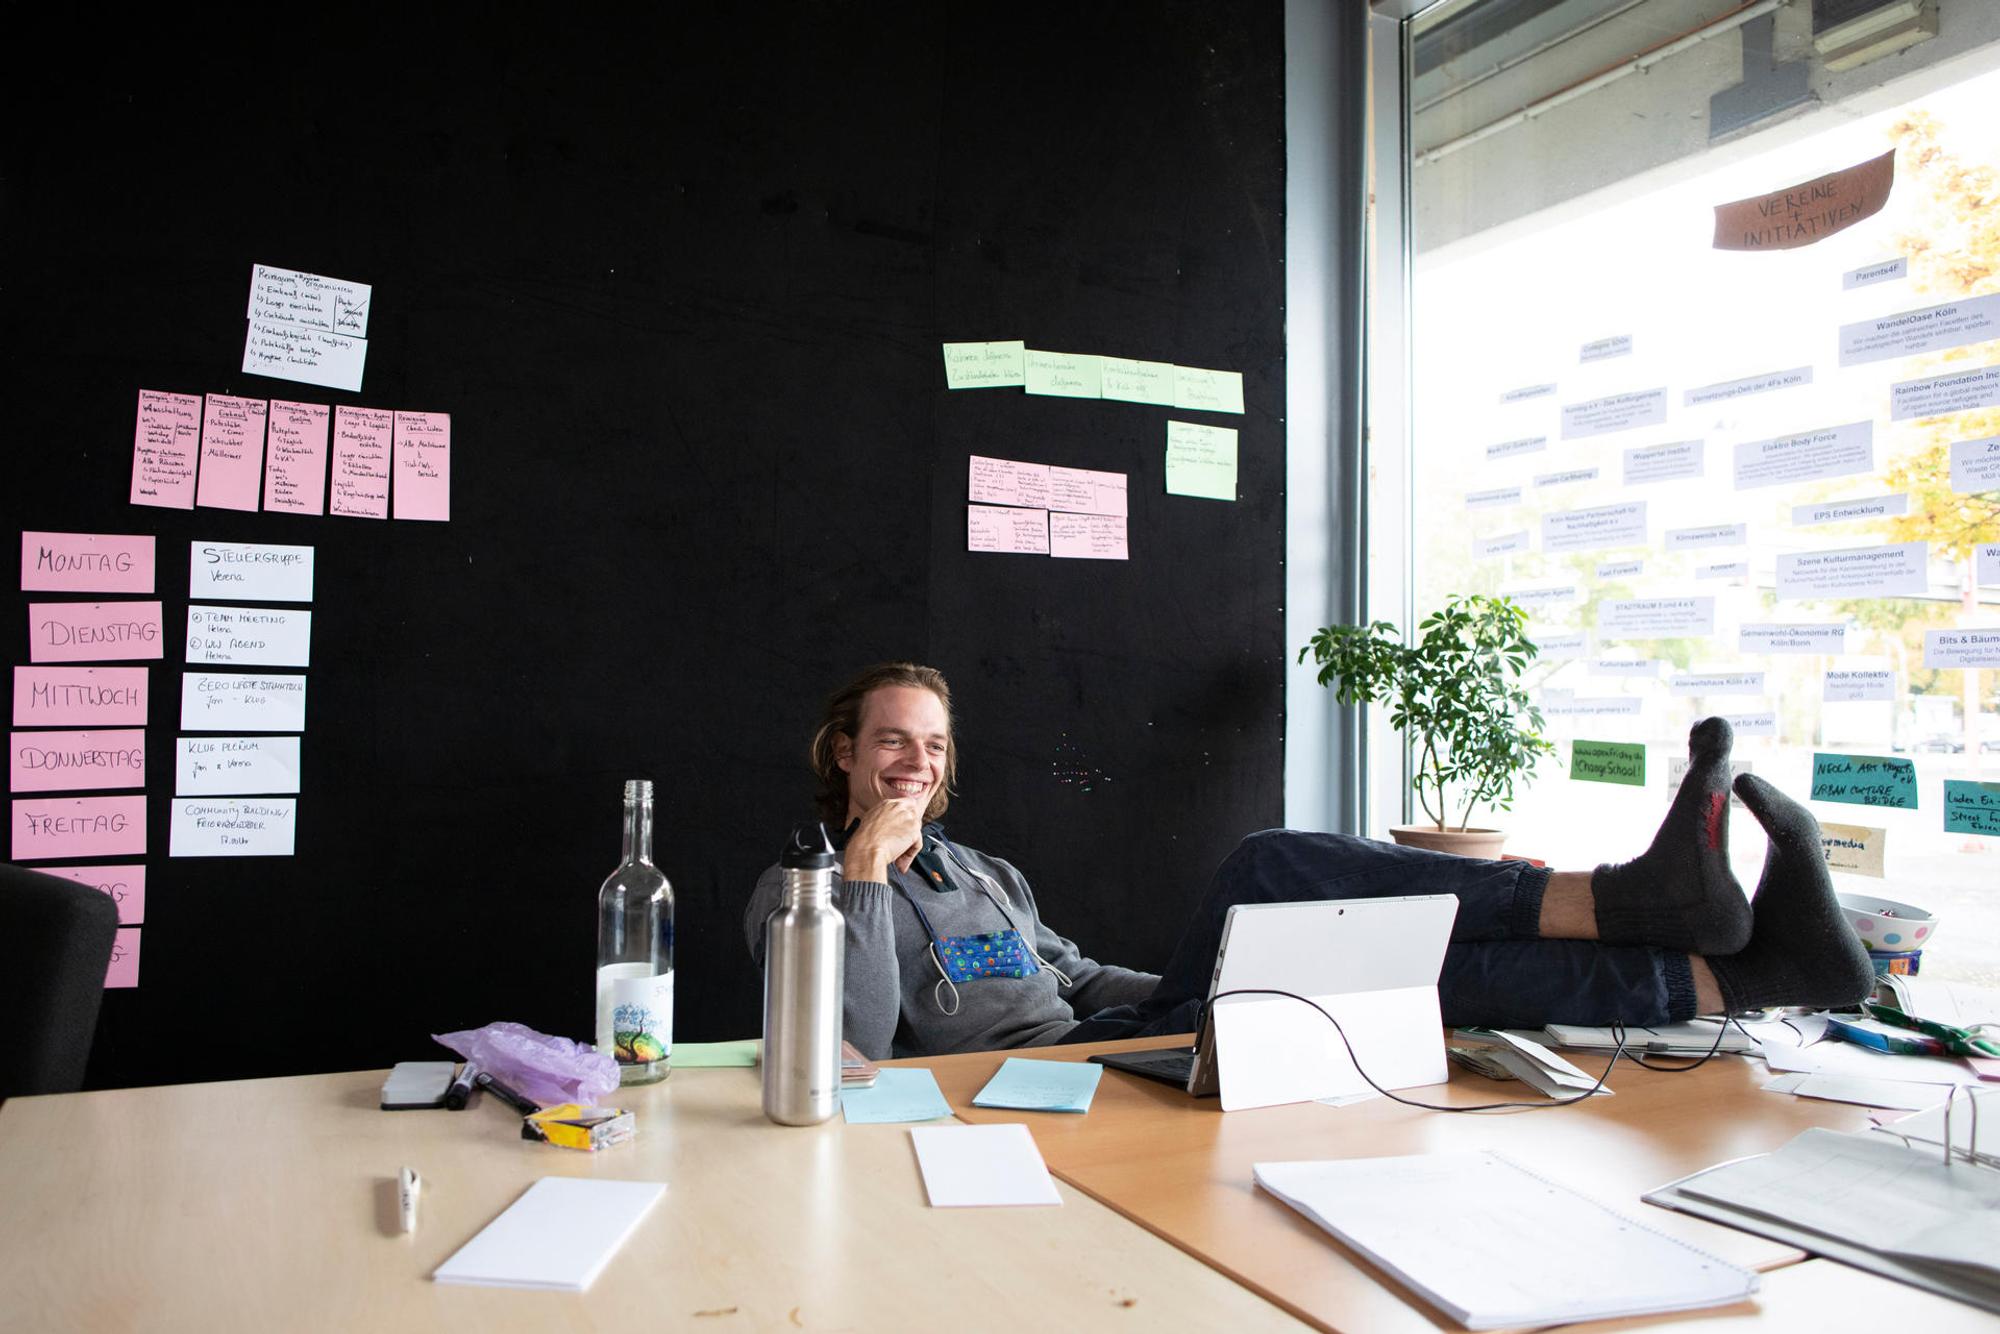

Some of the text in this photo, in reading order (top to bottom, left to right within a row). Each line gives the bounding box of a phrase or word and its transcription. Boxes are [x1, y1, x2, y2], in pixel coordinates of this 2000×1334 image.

[1758, 181, 1840, 217] VEREINE
[1744, 196, 1864, 248] INITIATIVEN
[1876, 307, 1957, 330] WandelOase Köln
[1896, 382, 1931, 395] Rainbow
[1934, 374, 1984, 388] Foundation
[1834, 505, 1885, 518] Entwicklung
[38, 546, 134, 572] MONTAG
[1824, 550, 1904, 564] Kulturmanagement
[41, 621, 160, 646] DIENSTAG
[1831, 628, 1844, 636] RG
[1939, 636, 1958, 644] Bits
[1960, 636, 1968, 644] &
[1827, 670, 1889, 680] Mode Kollektiv
[32, 682, 138, 708] MITTWOCH
[20, 748, 144, 770] DONNERSTAG
[26, 812, 130, 836] FREITAG
